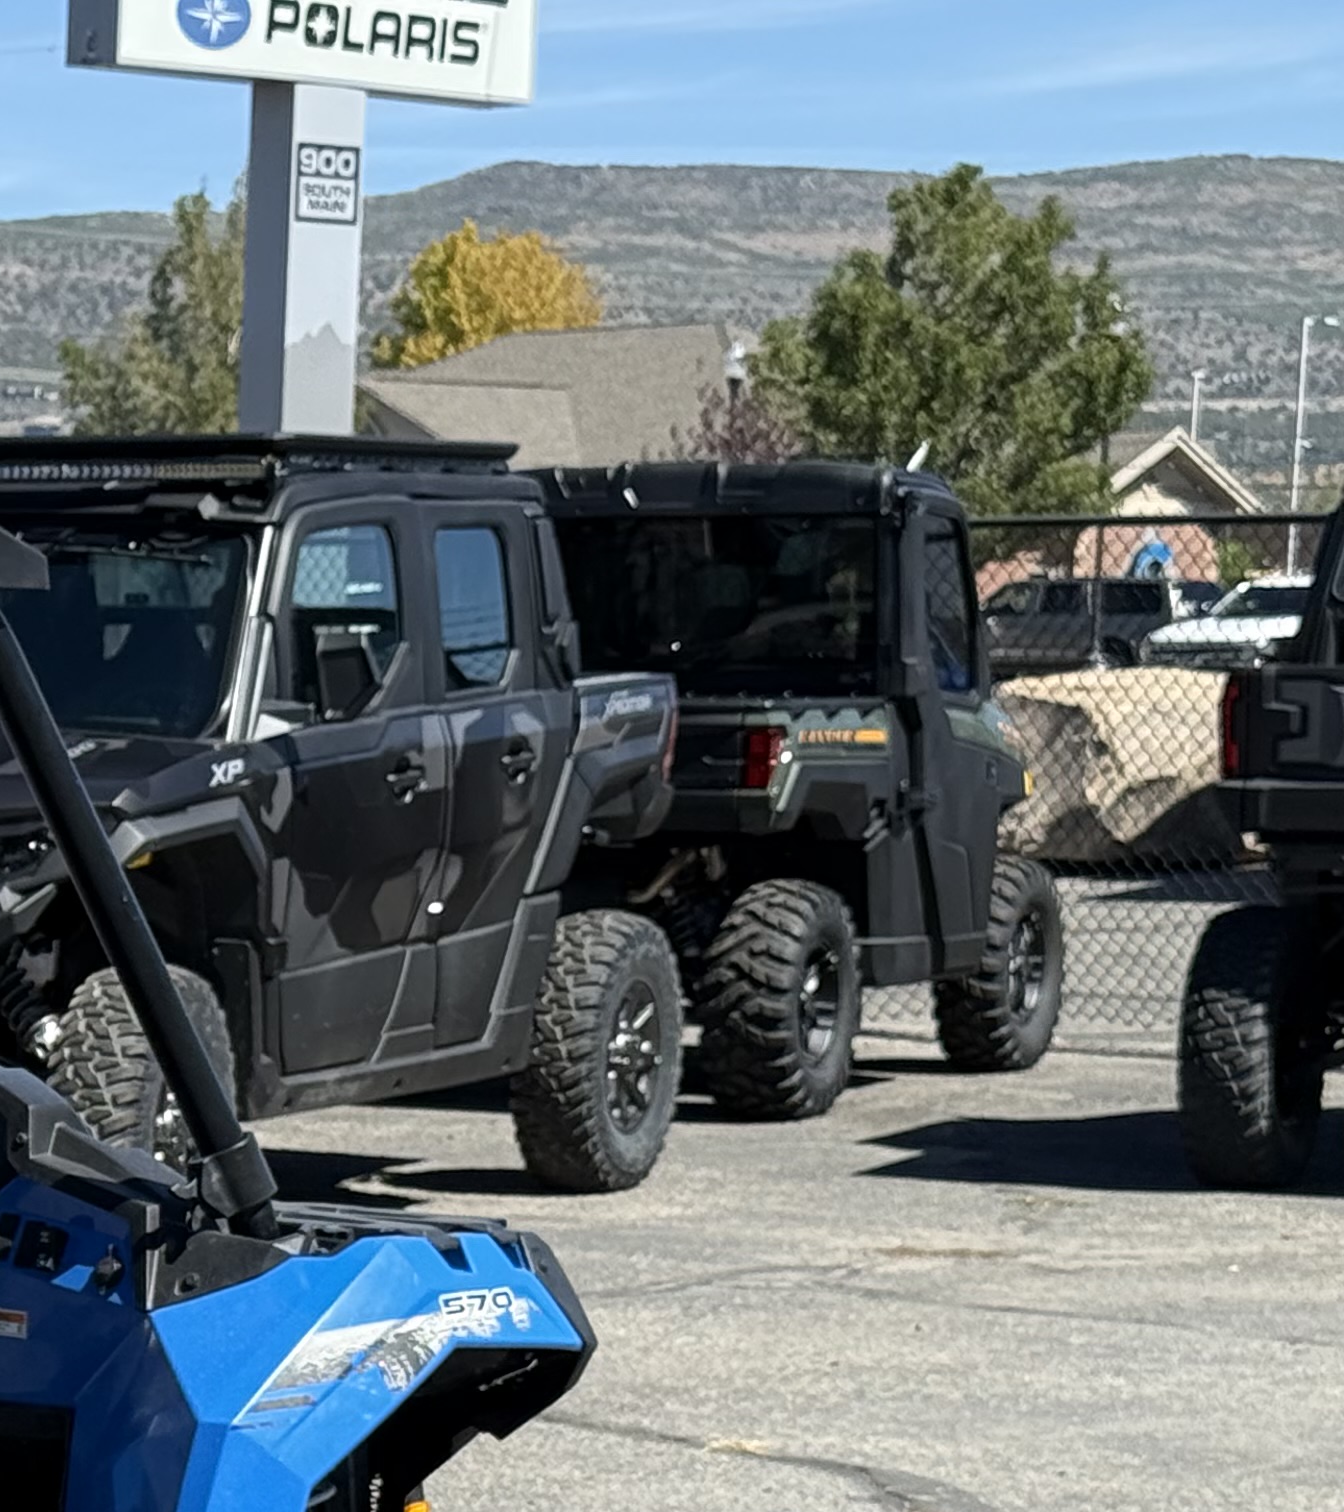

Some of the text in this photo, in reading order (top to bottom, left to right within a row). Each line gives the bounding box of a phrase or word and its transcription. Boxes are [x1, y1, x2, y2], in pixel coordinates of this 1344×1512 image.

[264, 0, 480, 66] POLARIS
[300, 147, 357, 178] 900
[303, 183, 352, 199] SOUTH
[208, 758, 245, 788] XP
[441, 1286, 514, 1316] 570
